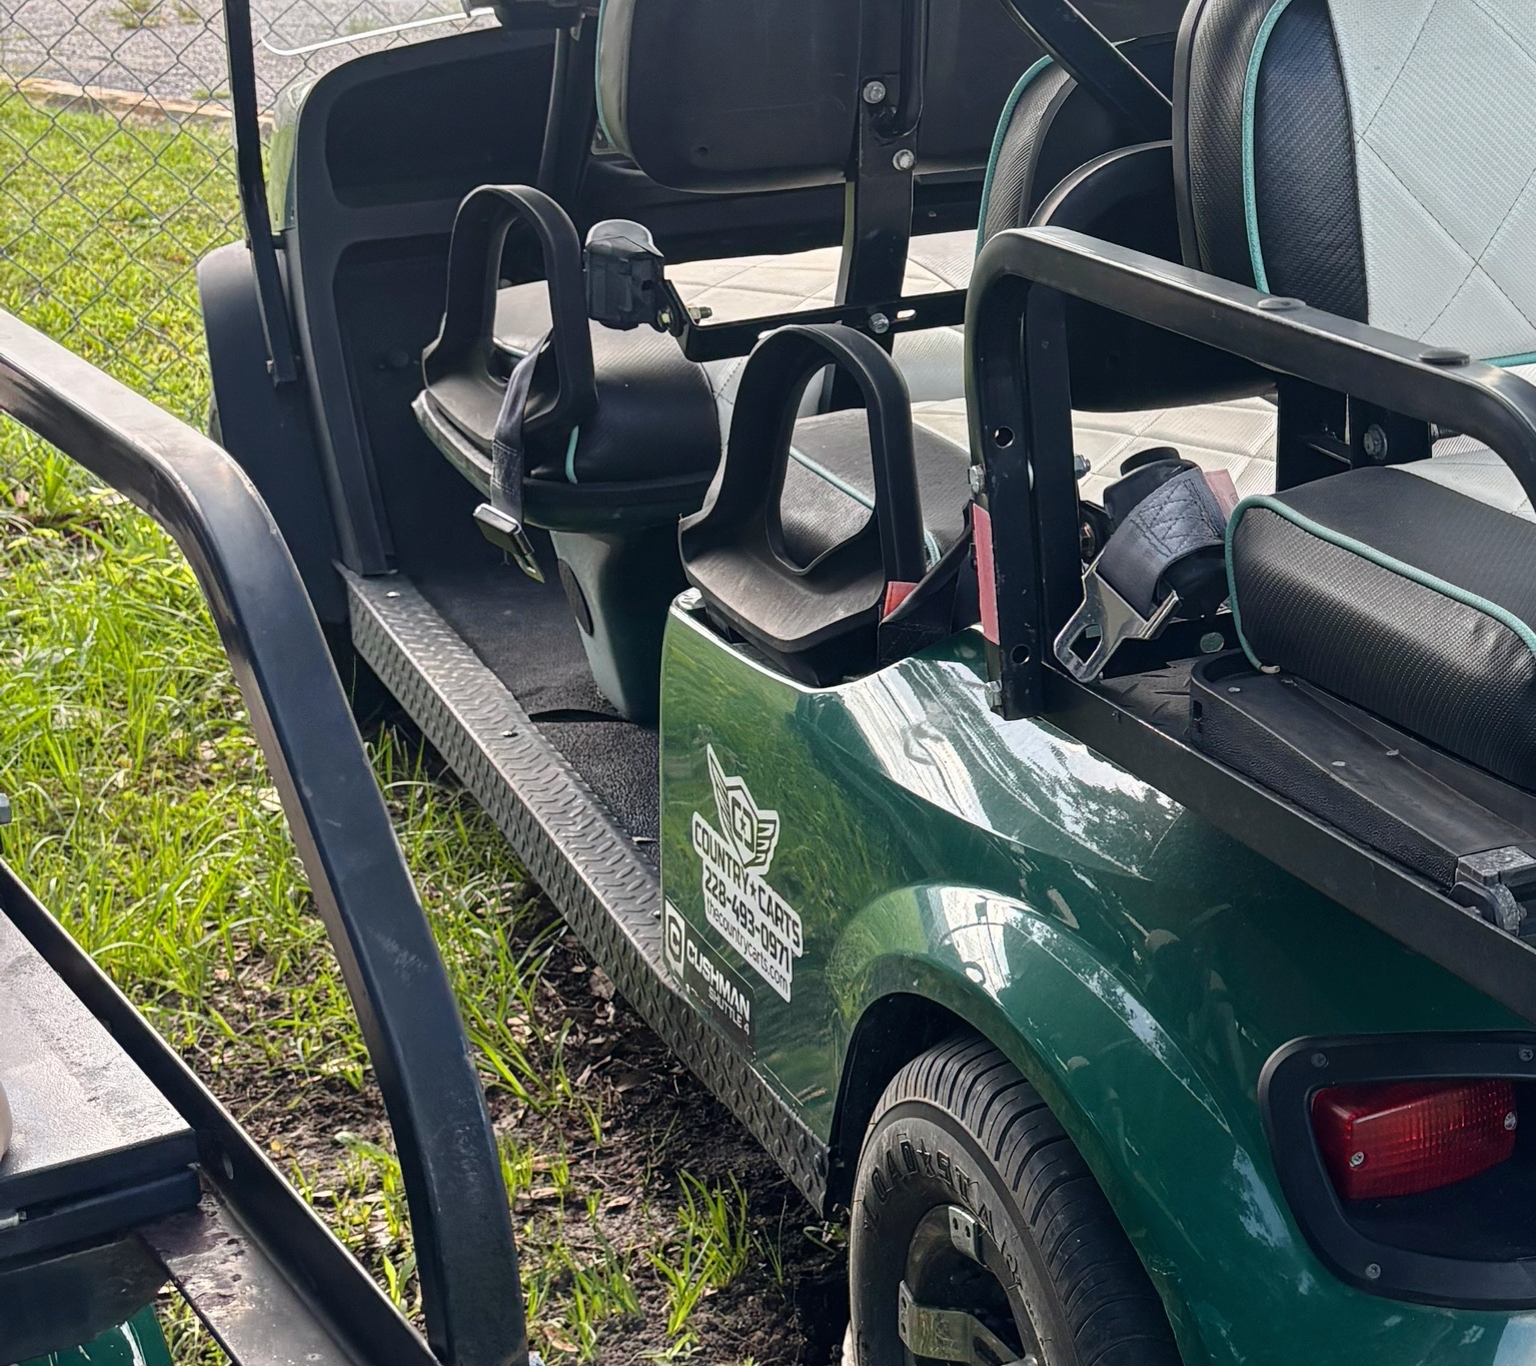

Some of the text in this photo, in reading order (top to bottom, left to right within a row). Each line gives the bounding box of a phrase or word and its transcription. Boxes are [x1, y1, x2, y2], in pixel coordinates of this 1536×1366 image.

[694, 819, 801, 950] COUNTRY CARTS
[704, 864, 790, 975] 228-493-0971
[686, 938, 750, 1022] CUSHMAN
[706, 897, 789, 996] thecountrycarts.com
[708, 985, 743, 1029] SHUTTLE
